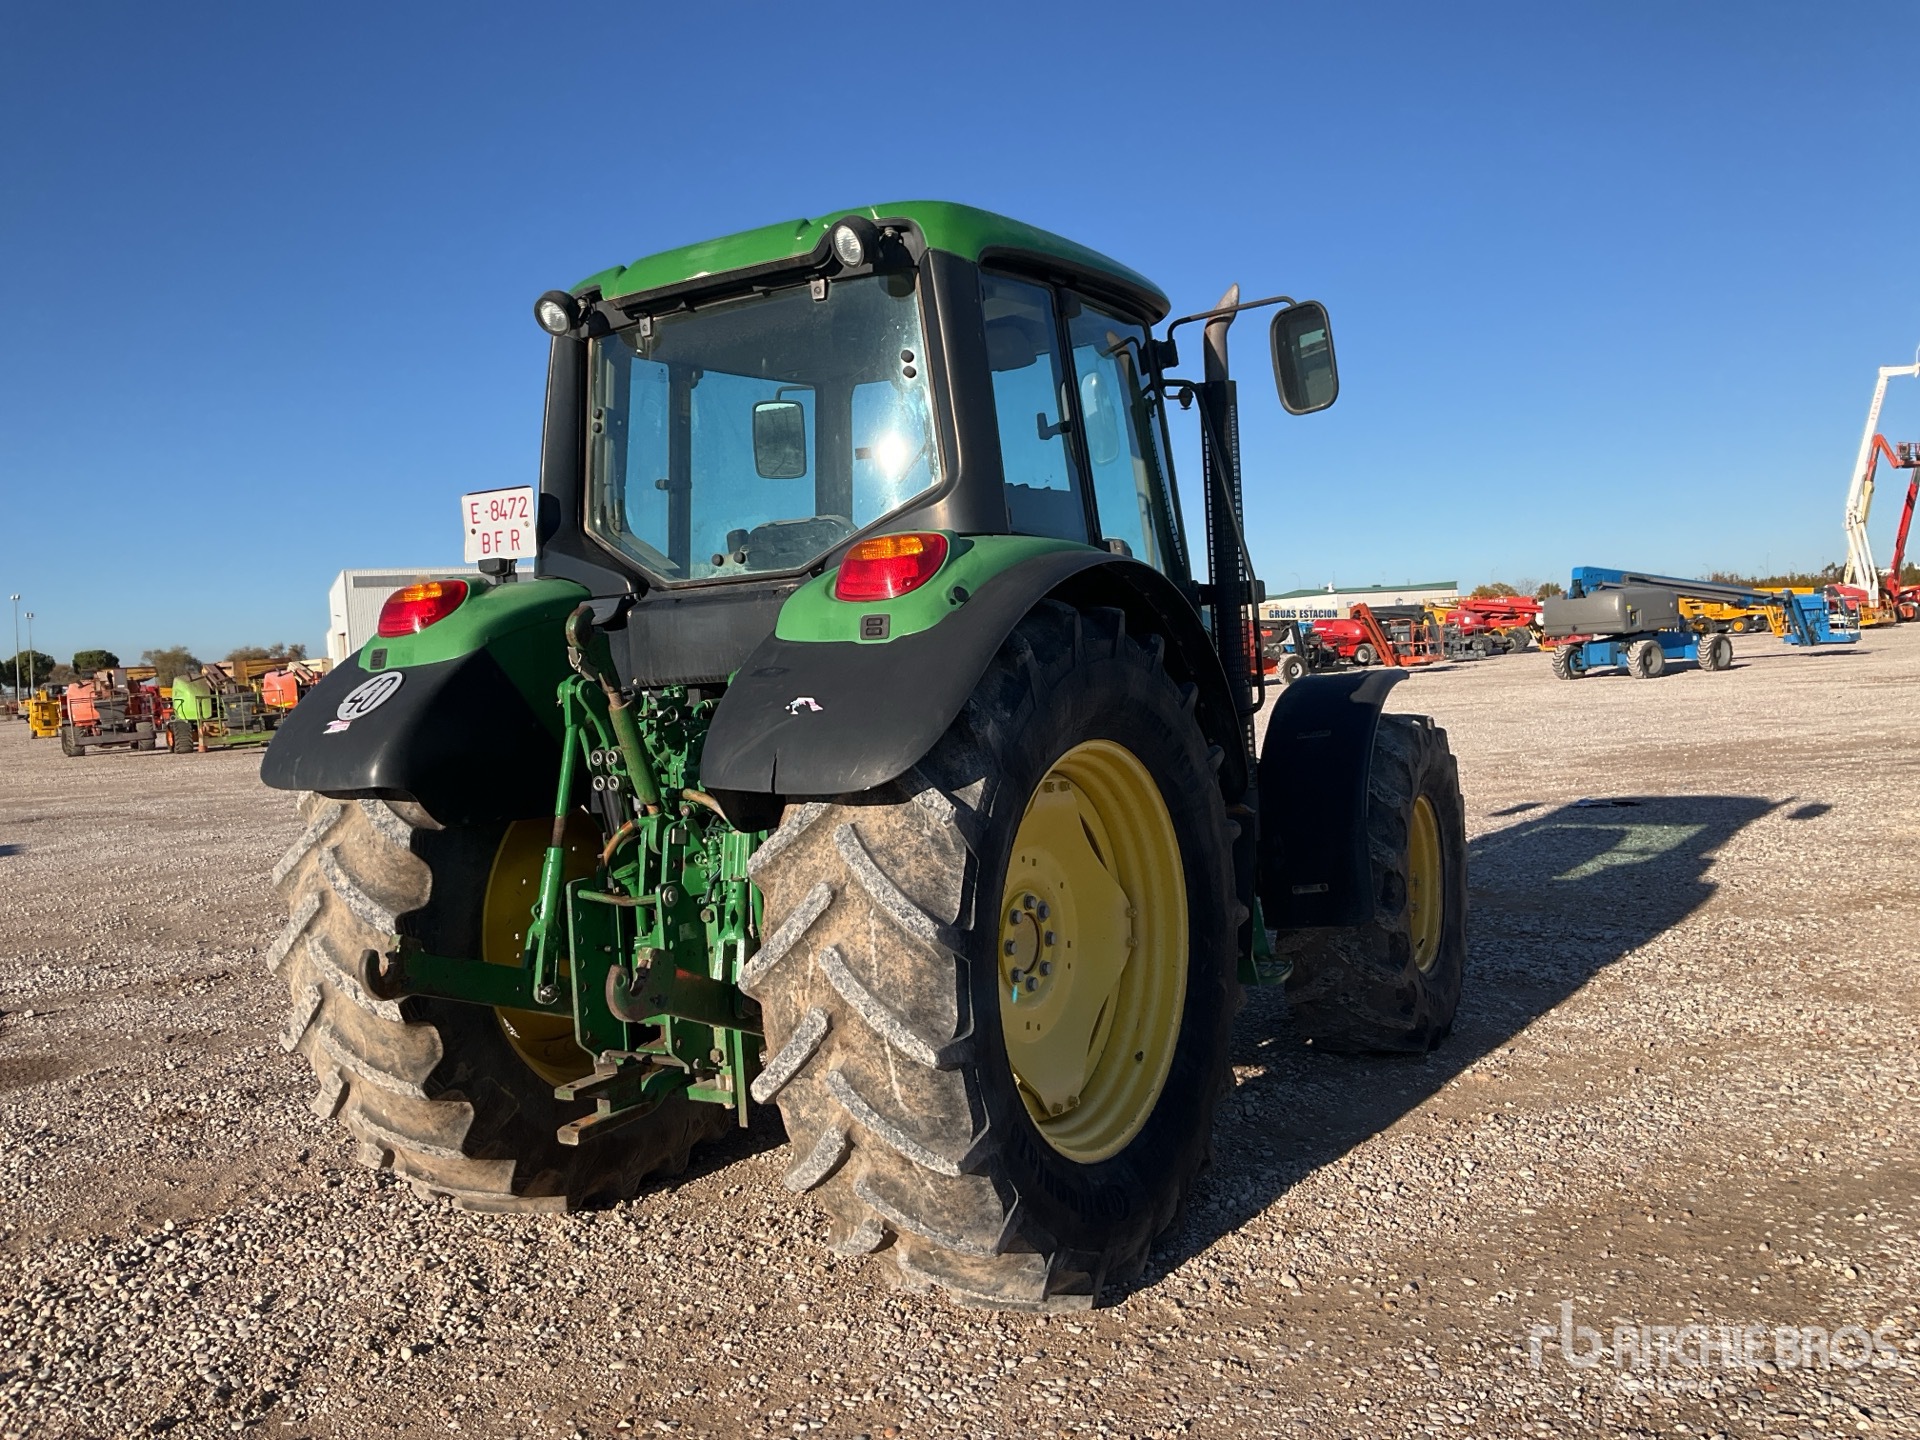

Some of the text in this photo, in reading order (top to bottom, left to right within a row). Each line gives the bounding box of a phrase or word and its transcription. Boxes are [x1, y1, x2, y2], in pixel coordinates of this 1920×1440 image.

[1269, 609, 1338, 618] GRUAS ESTACION
[345, 676, 398, 713] 40
